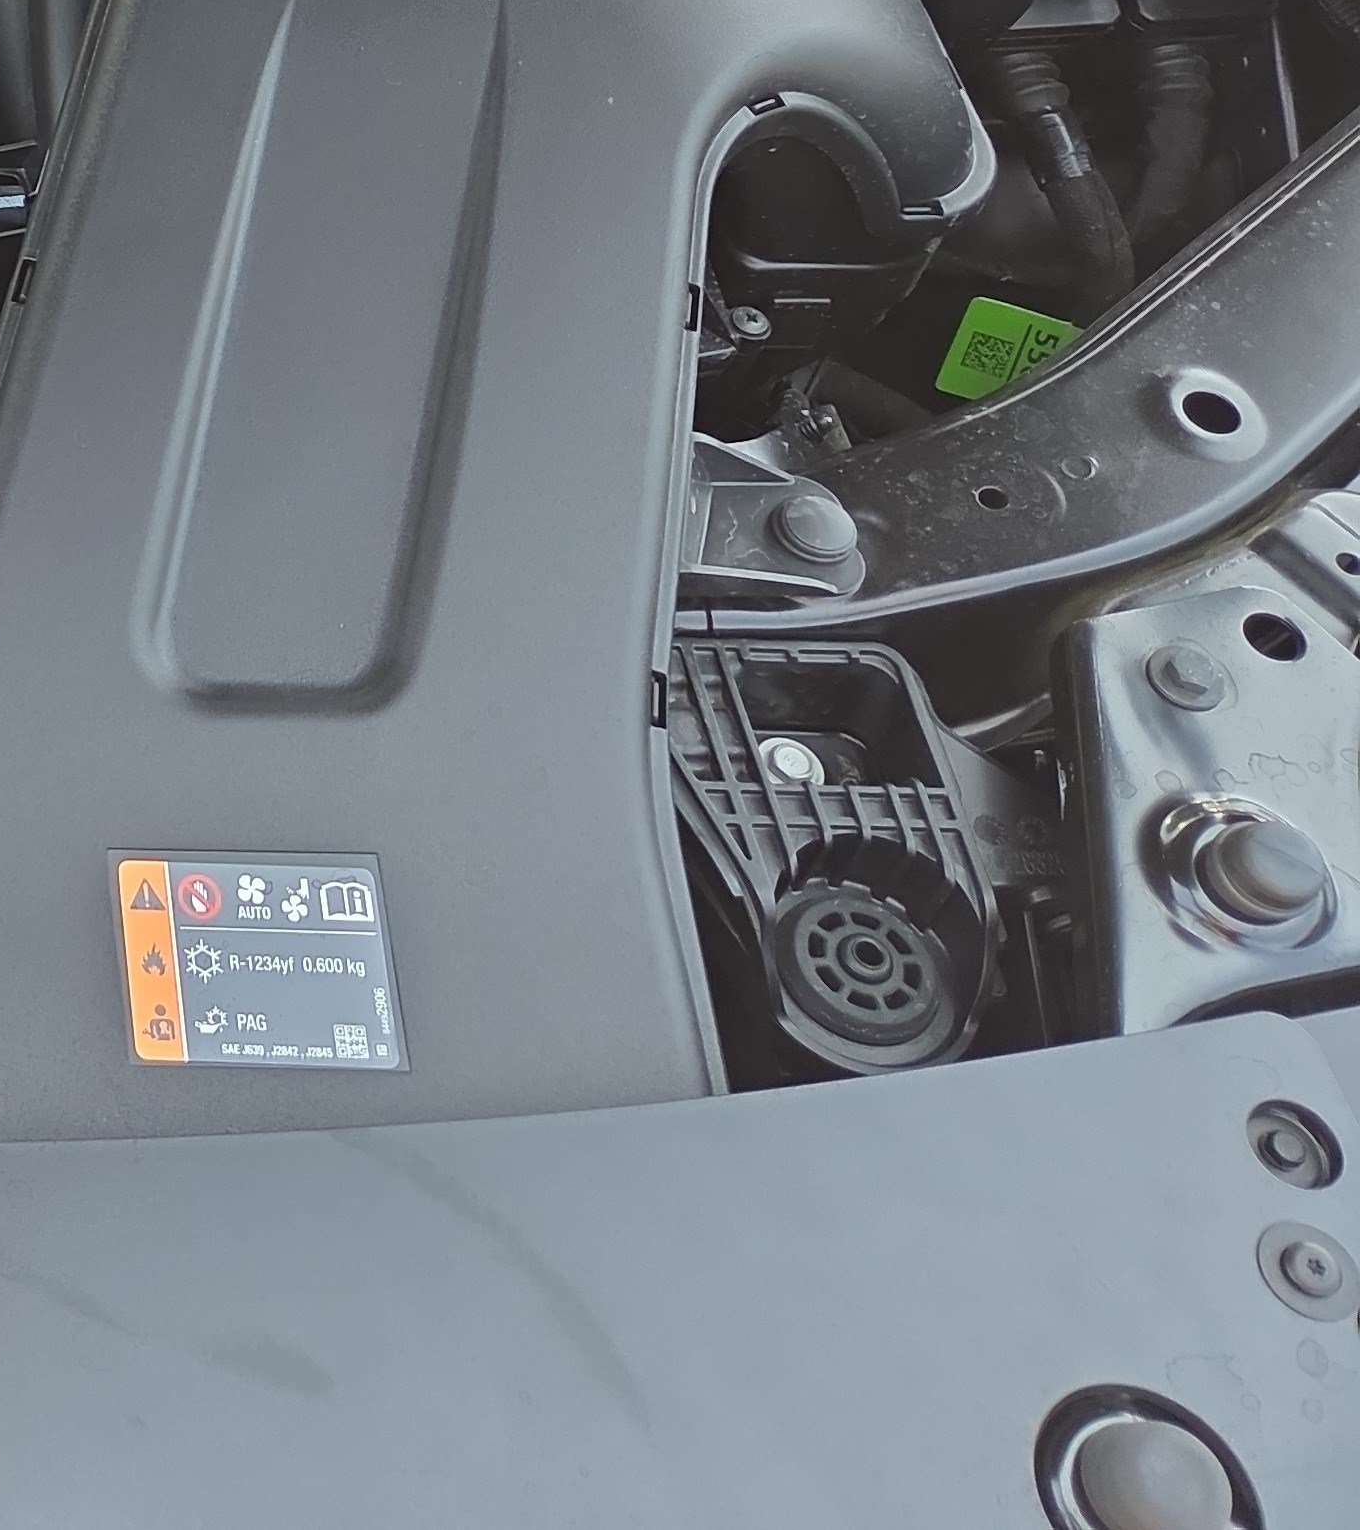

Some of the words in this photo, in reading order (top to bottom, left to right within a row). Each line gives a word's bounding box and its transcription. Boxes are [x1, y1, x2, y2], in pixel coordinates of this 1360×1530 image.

[1019, 329, 1061, 375] 55
[237, 906, 272, 920] AUTO
[229, 954, 295, 975] R-1234yf
[302, 956, 344, 974] 0.600
[347, 957, 366, 977] kg
[237, 1014, 267, 1031] PAG
[222, 1043, 241, 1054] SAE
[306, 1046, 334, 1058] J2845
